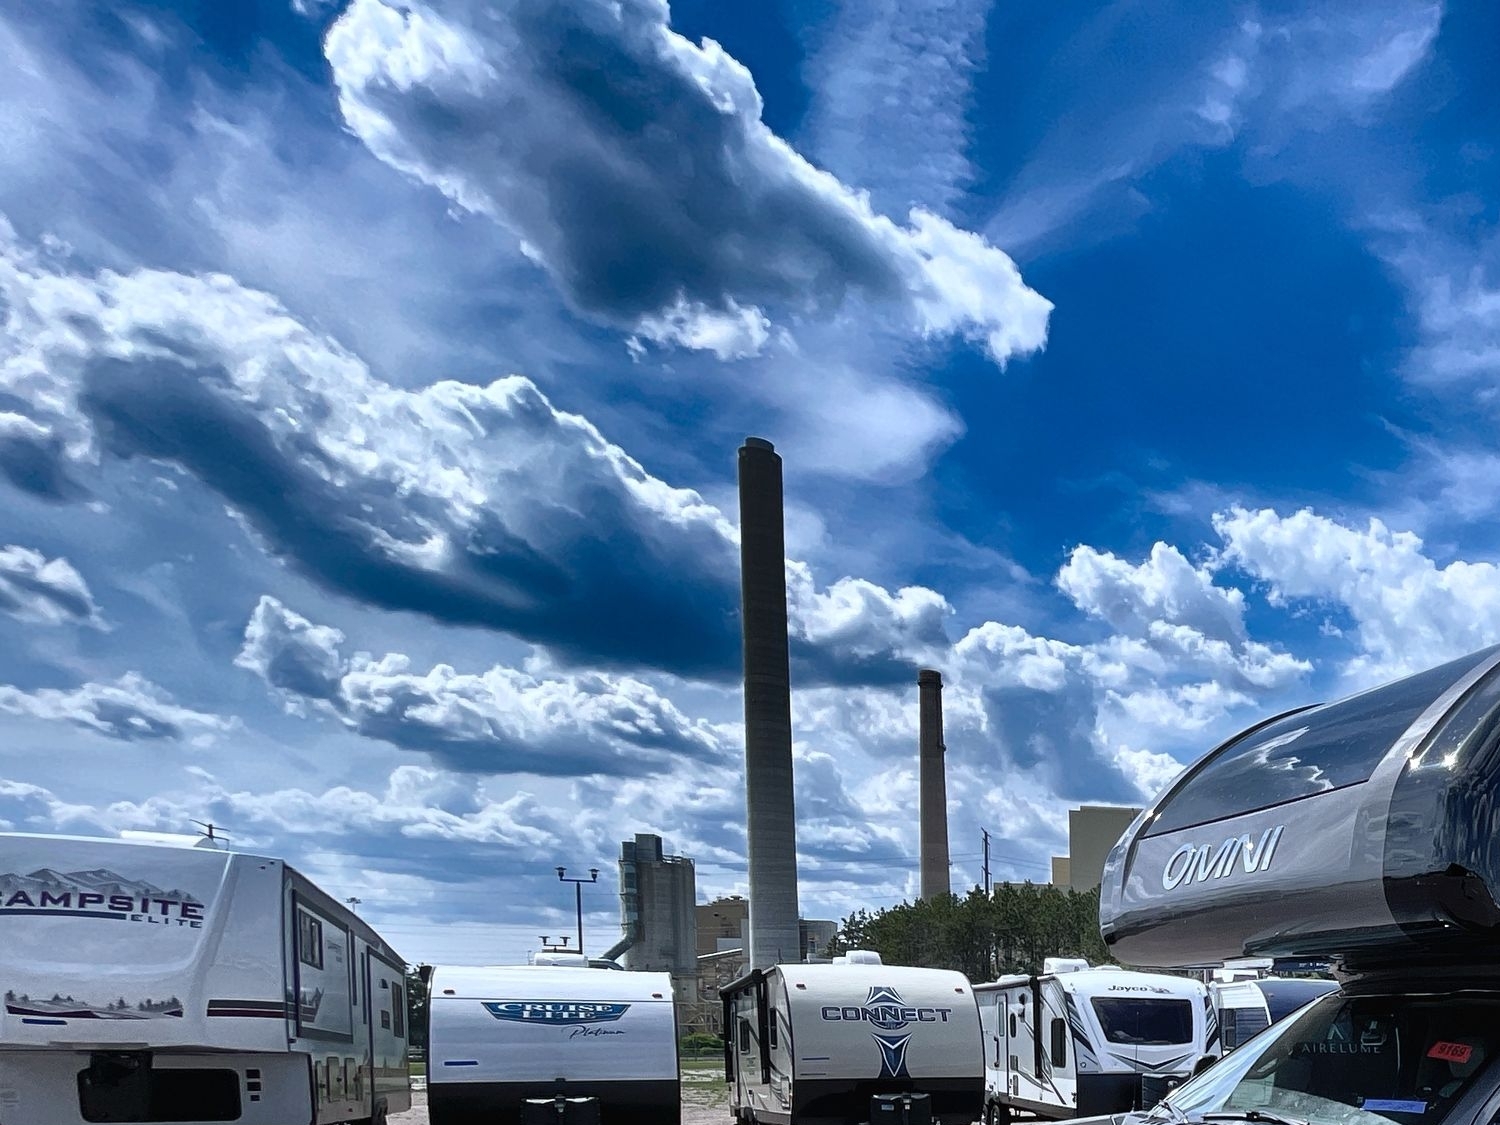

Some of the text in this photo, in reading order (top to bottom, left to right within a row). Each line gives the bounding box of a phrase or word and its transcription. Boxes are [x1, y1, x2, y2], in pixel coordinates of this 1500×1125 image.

[1162, 825, 1284, 891] OMNI
[0, 890, 205, 921] AMPSITE
[130, 914, 203, 929] ELITE
[1107, 984, 1148, 994] Jayco
[498, 1003, 613, 1012] CRUISE
[522, 1009, 597, 1019] LITE
[820, 1005, 952, 1023] CONNECT
[561, 1024, 627, 1040] Platinum
[1301, 1040, 1381, 1054] AIRELUME
